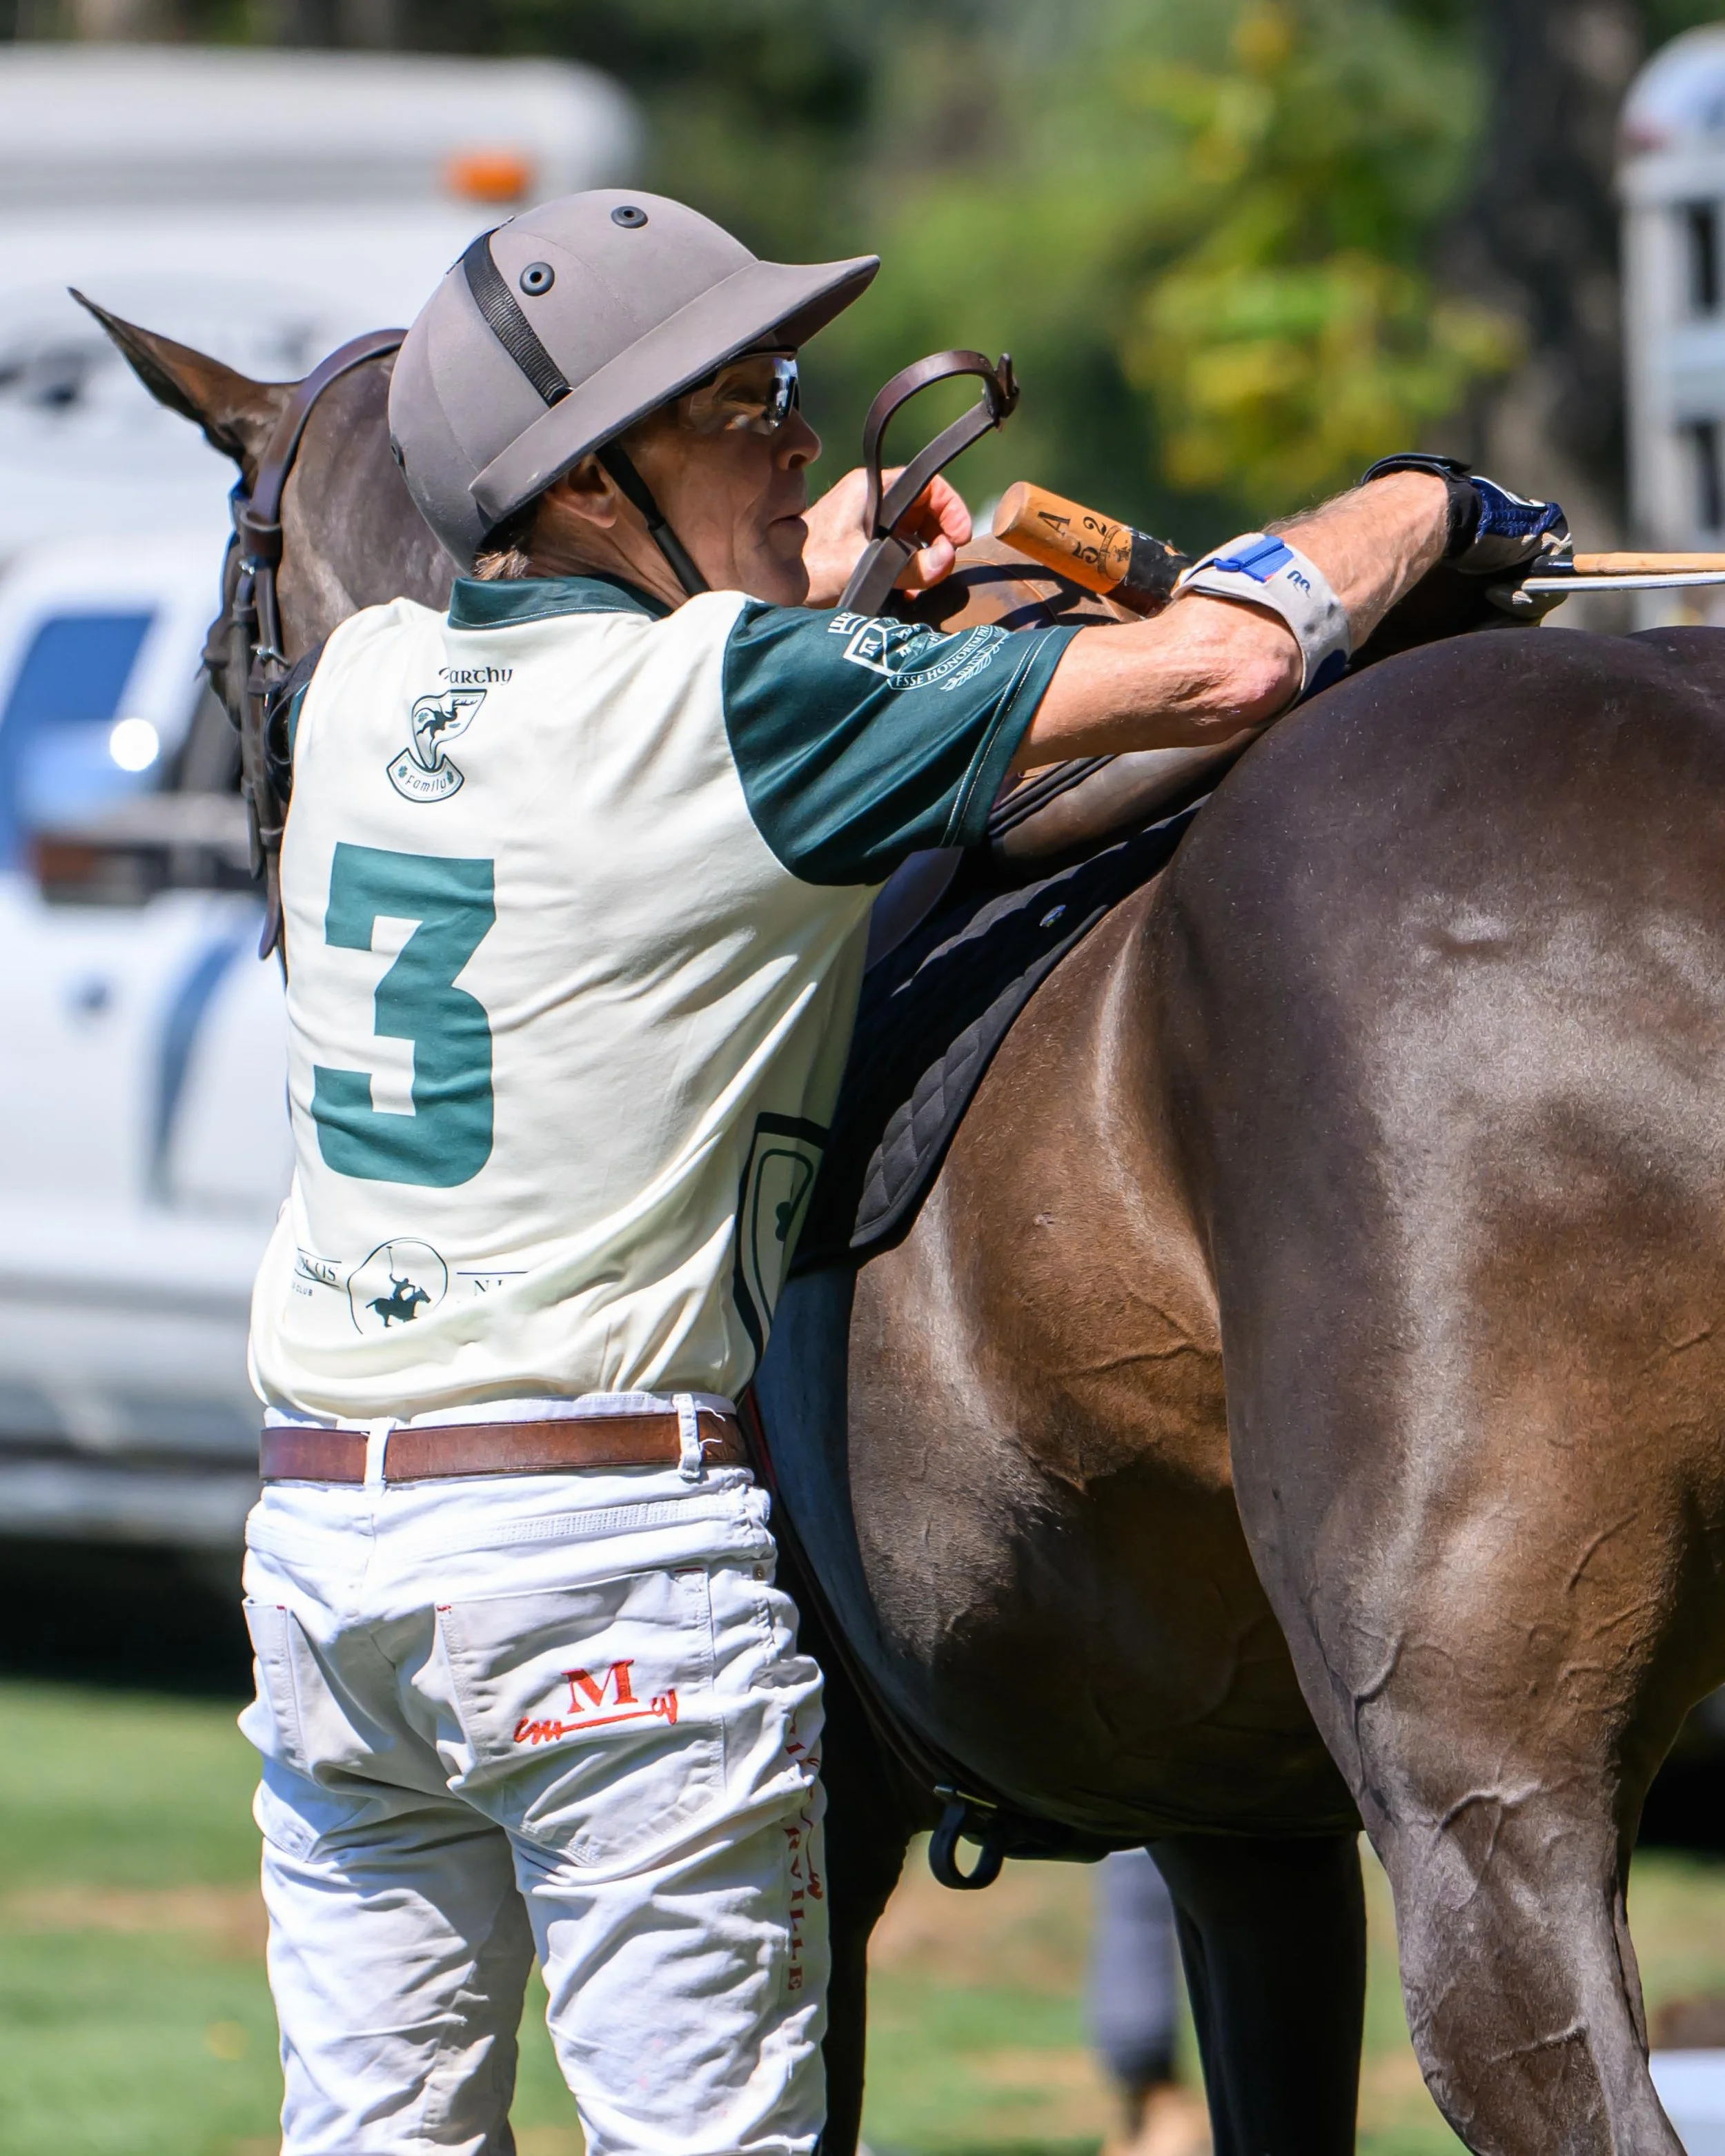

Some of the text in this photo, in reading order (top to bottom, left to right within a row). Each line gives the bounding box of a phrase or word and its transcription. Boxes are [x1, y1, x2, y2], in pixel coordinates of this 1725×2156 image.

[1037, 511, 1071, 537] A
[405, 774, 448, 793] Family
[310, 841, 497, 1189] 3
[560, 1659, 639, 1714] M
